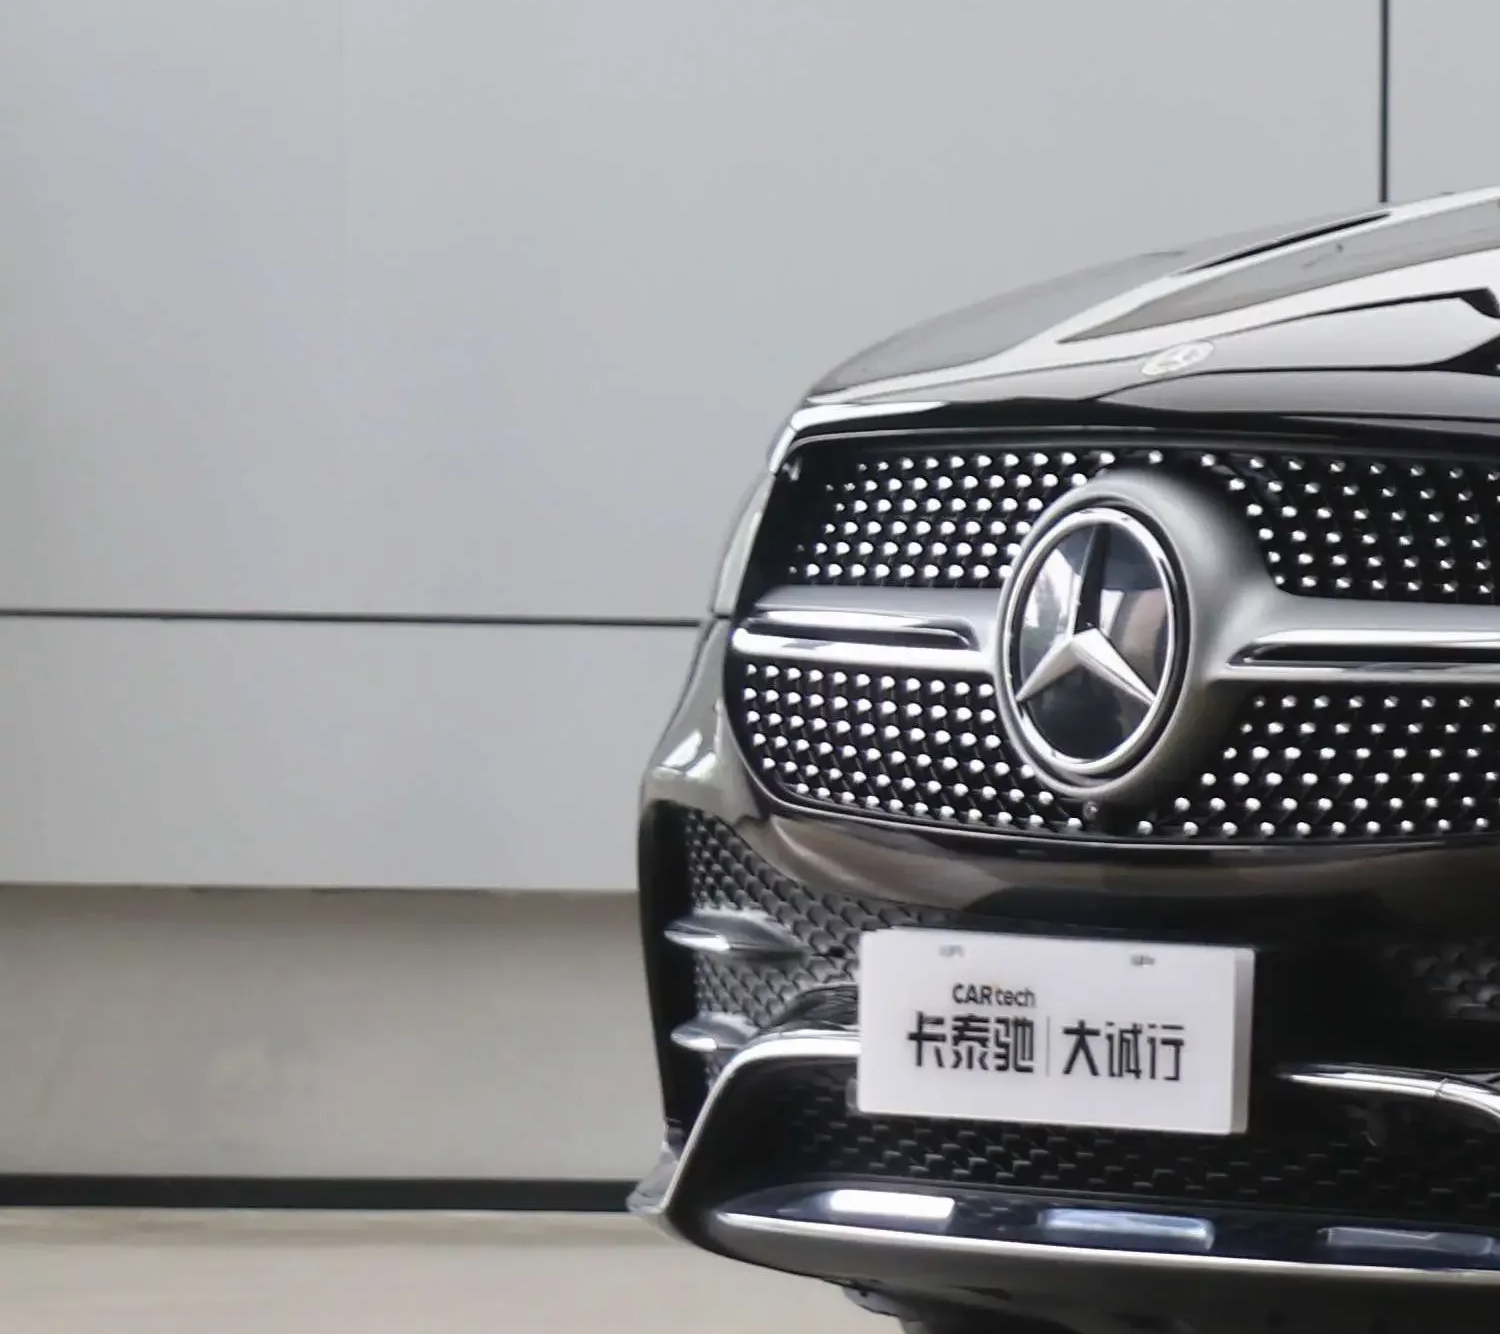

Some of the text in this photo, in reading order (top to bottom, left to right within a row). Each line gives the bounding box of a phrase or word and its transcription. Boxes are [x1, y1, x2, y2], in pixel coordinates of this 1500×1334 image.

[951, 982, 1037, 1008] CARtech
[906, 1010, 1035, 1074] 卡泰驰
[1061, 1019, 1185, 1082] 大诚行
